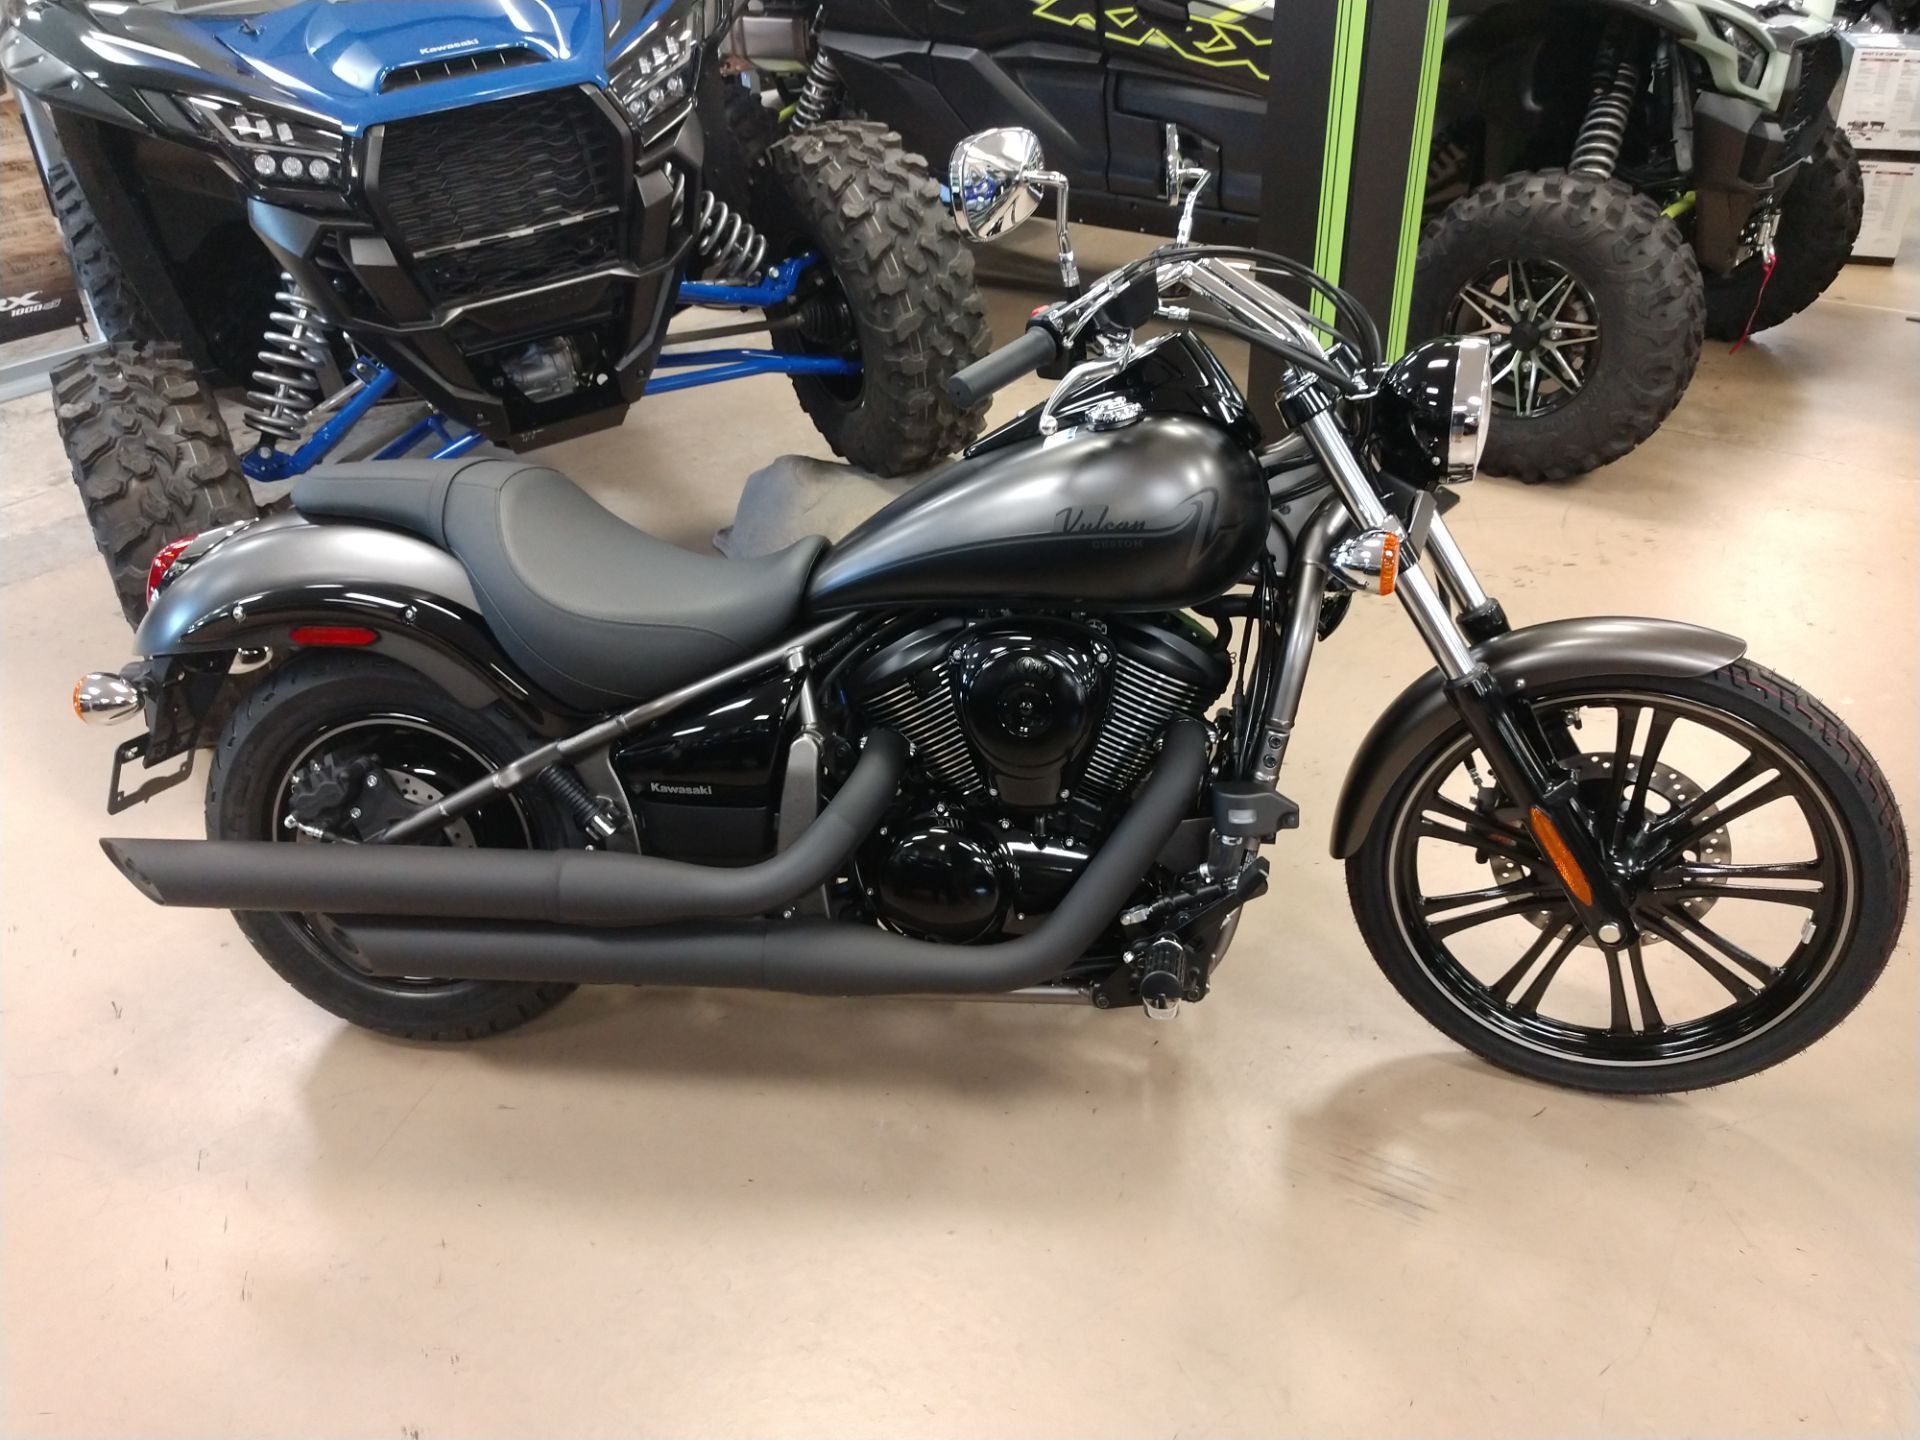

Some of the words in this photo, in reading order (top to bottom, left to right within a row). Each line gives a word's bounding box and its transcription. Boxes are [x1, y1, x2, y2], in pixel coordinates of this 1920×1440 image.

[420, 38, 479, 55] Kawasaki
[1055, 504, 1146, 533] Vulcan
[650, 782, 712, 795] Kawasaki
